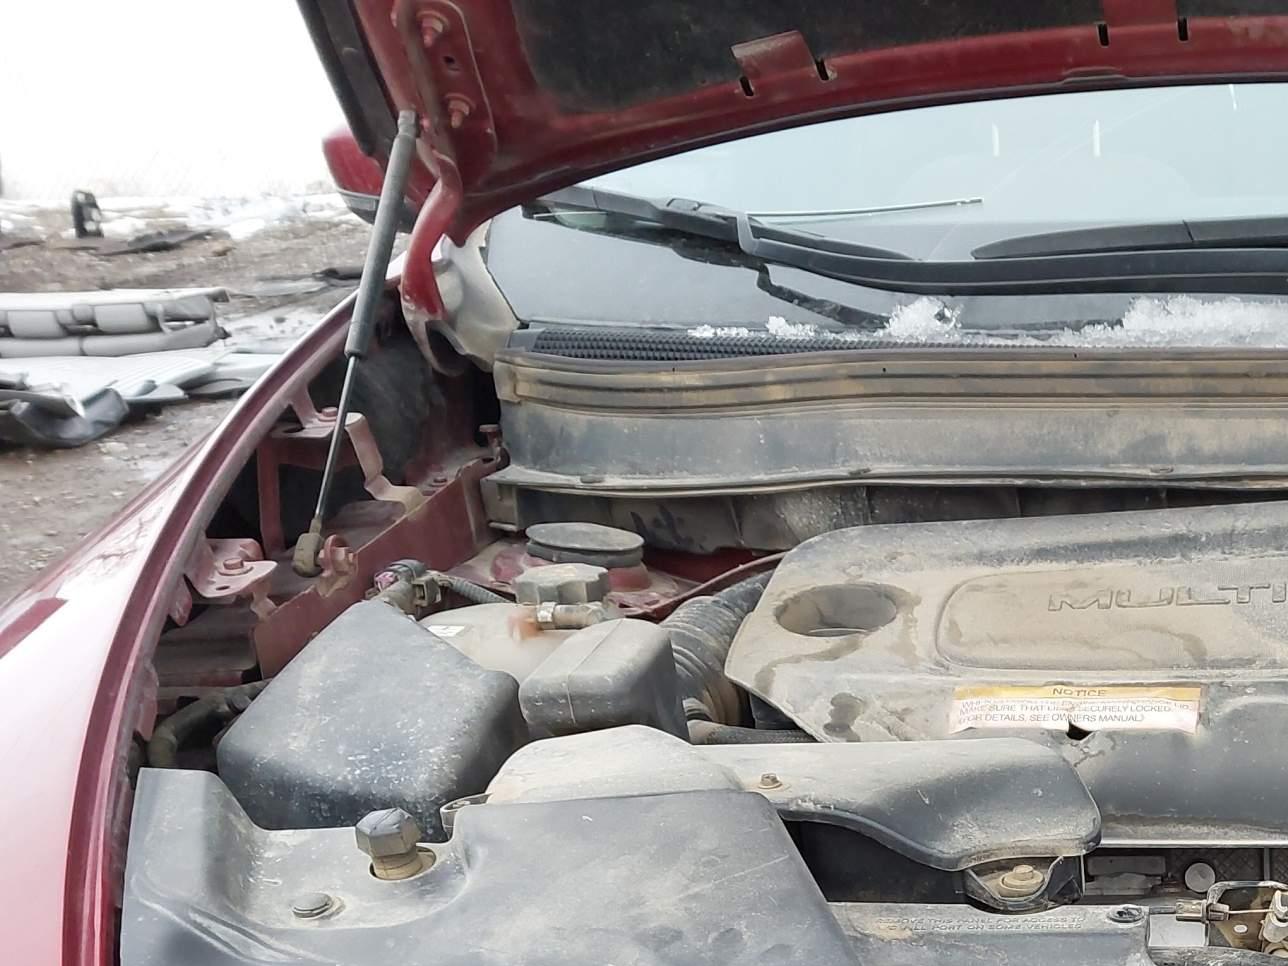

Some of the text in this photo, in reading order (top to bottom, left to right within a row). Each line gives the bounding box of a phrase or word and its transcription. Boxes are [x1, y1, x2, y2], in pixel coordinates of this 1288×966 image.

[1052, 687, 1107, 697] NOTICE
[989, 704, 1016, 712] SURE
[1020, 704, 1043, 712] THAT
[1051, 713, 1096, 722] OWNERS
[1099, 714, 1145, 722] MANUAL)
